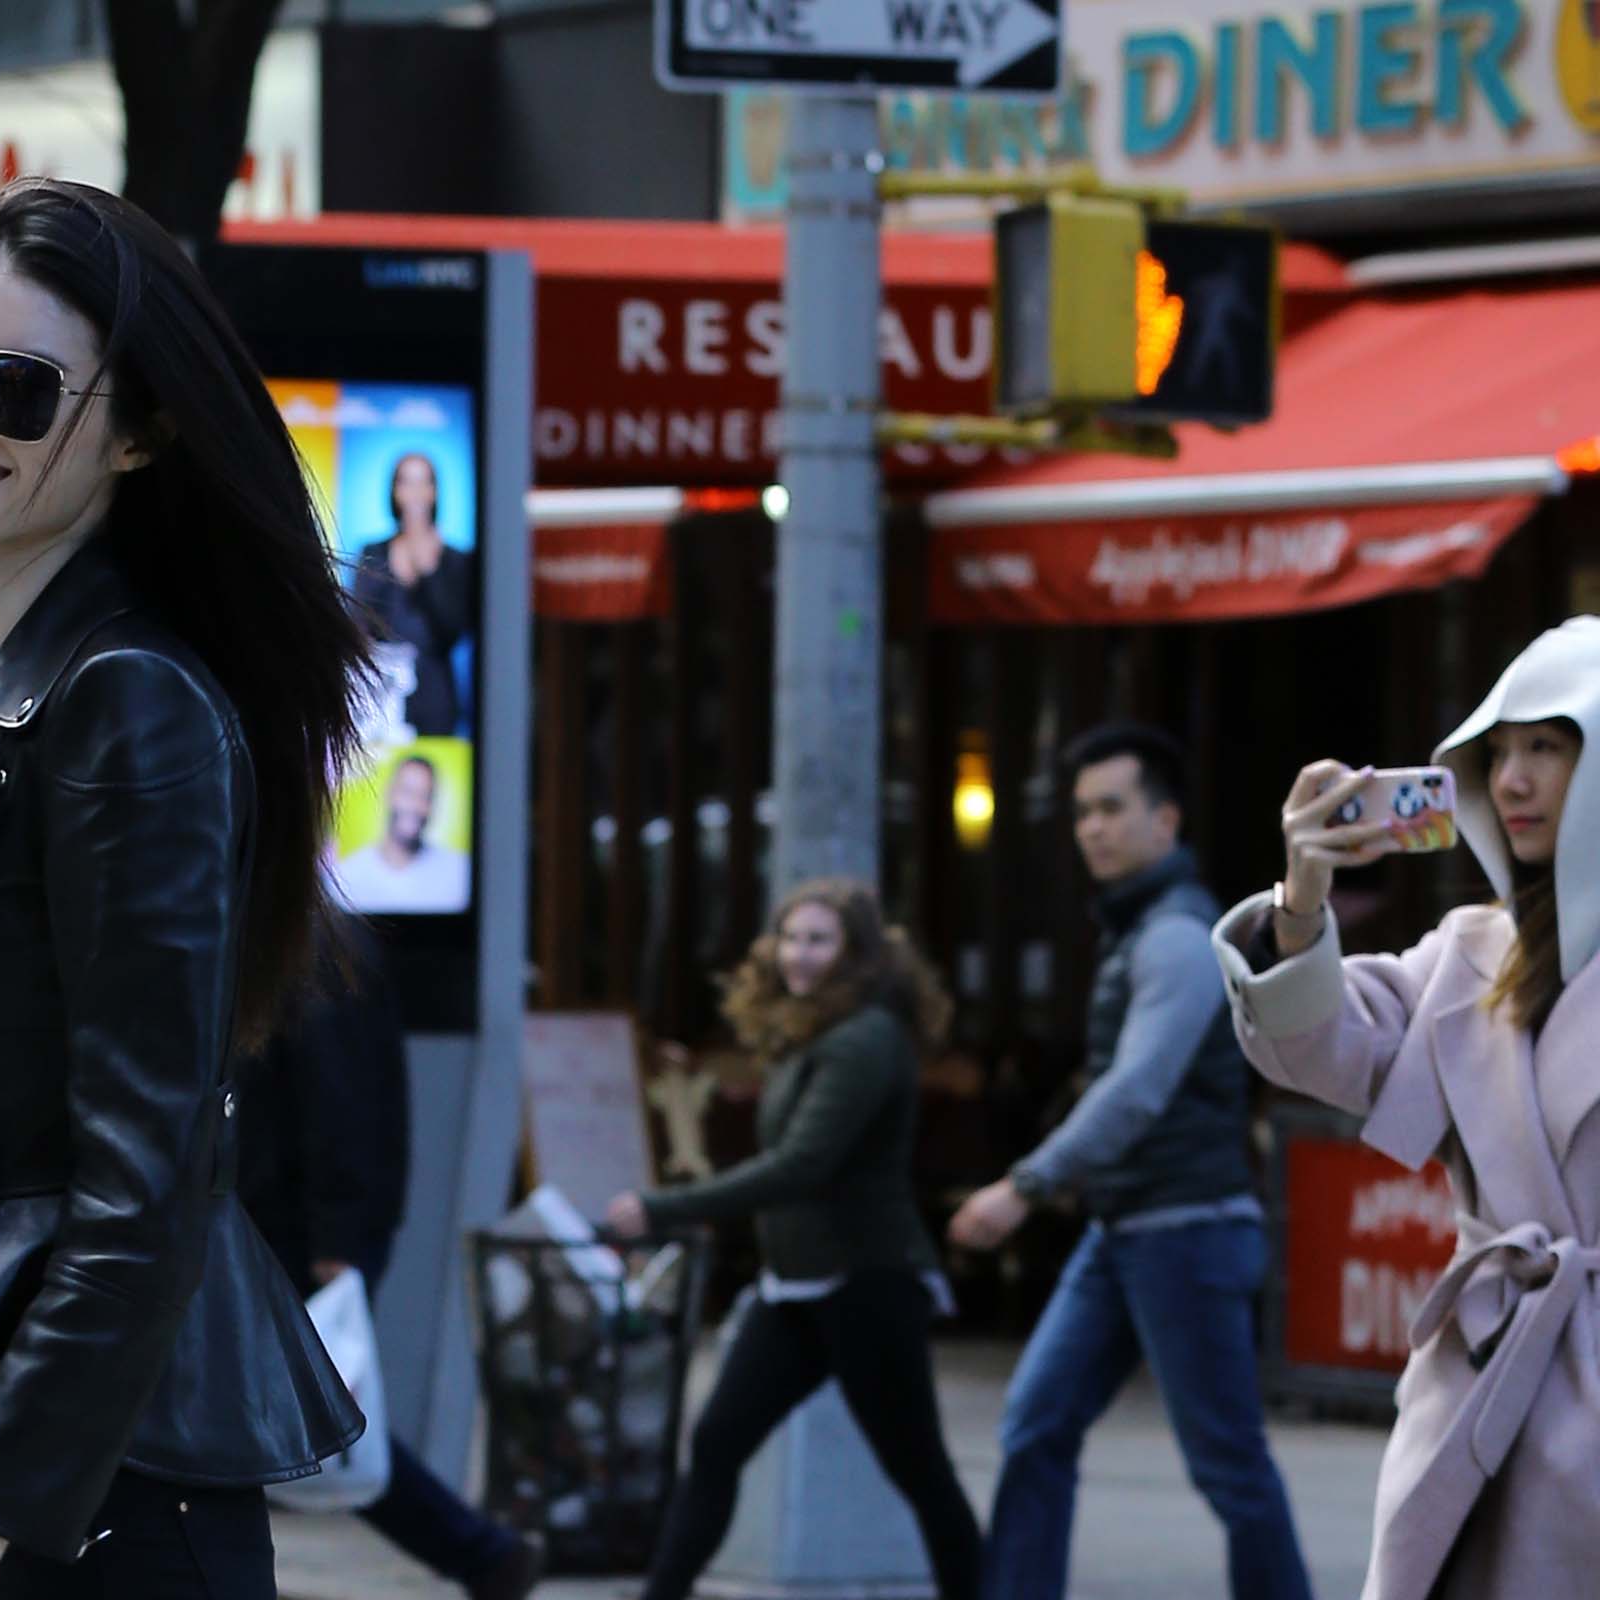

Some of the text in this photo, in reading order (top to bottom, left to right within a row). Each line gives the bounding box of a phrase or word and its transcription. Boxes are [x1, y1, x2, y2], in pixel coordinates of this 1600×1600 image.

[700, 0, 1008, 46] ONE WAY
[1121, 0, 1534, 168] DINER
[618, 300, 992, 380] RESAU
